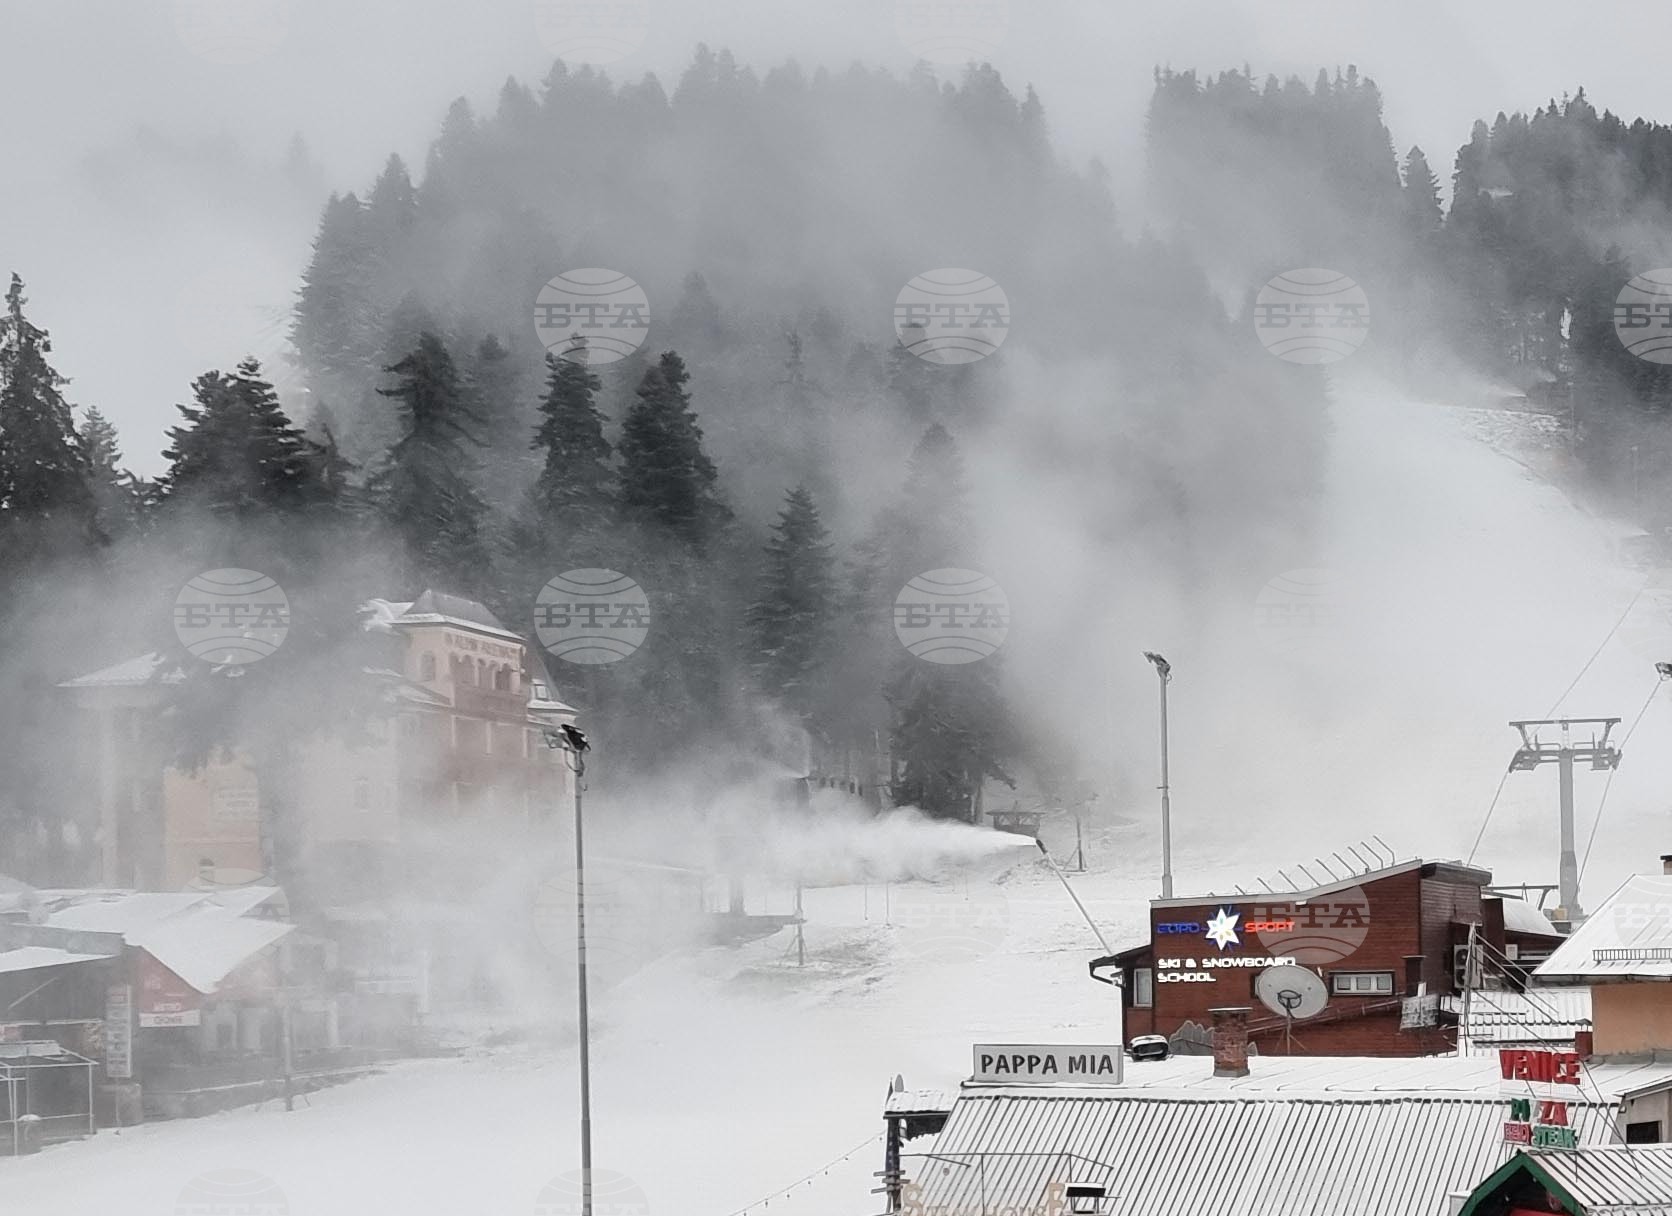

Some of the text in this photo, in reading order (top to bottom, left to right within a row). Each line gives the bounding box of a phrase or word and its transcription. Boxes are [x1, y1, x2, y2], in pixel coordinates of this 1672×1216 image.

[1157, 959, 1181, 969] SKI
[1157, 972, 1217, 983] SCHOOL
[980, 1054, 1114, 1075] PAPPA MIA
[1499, 1049, 1581, 1085] VENICE
